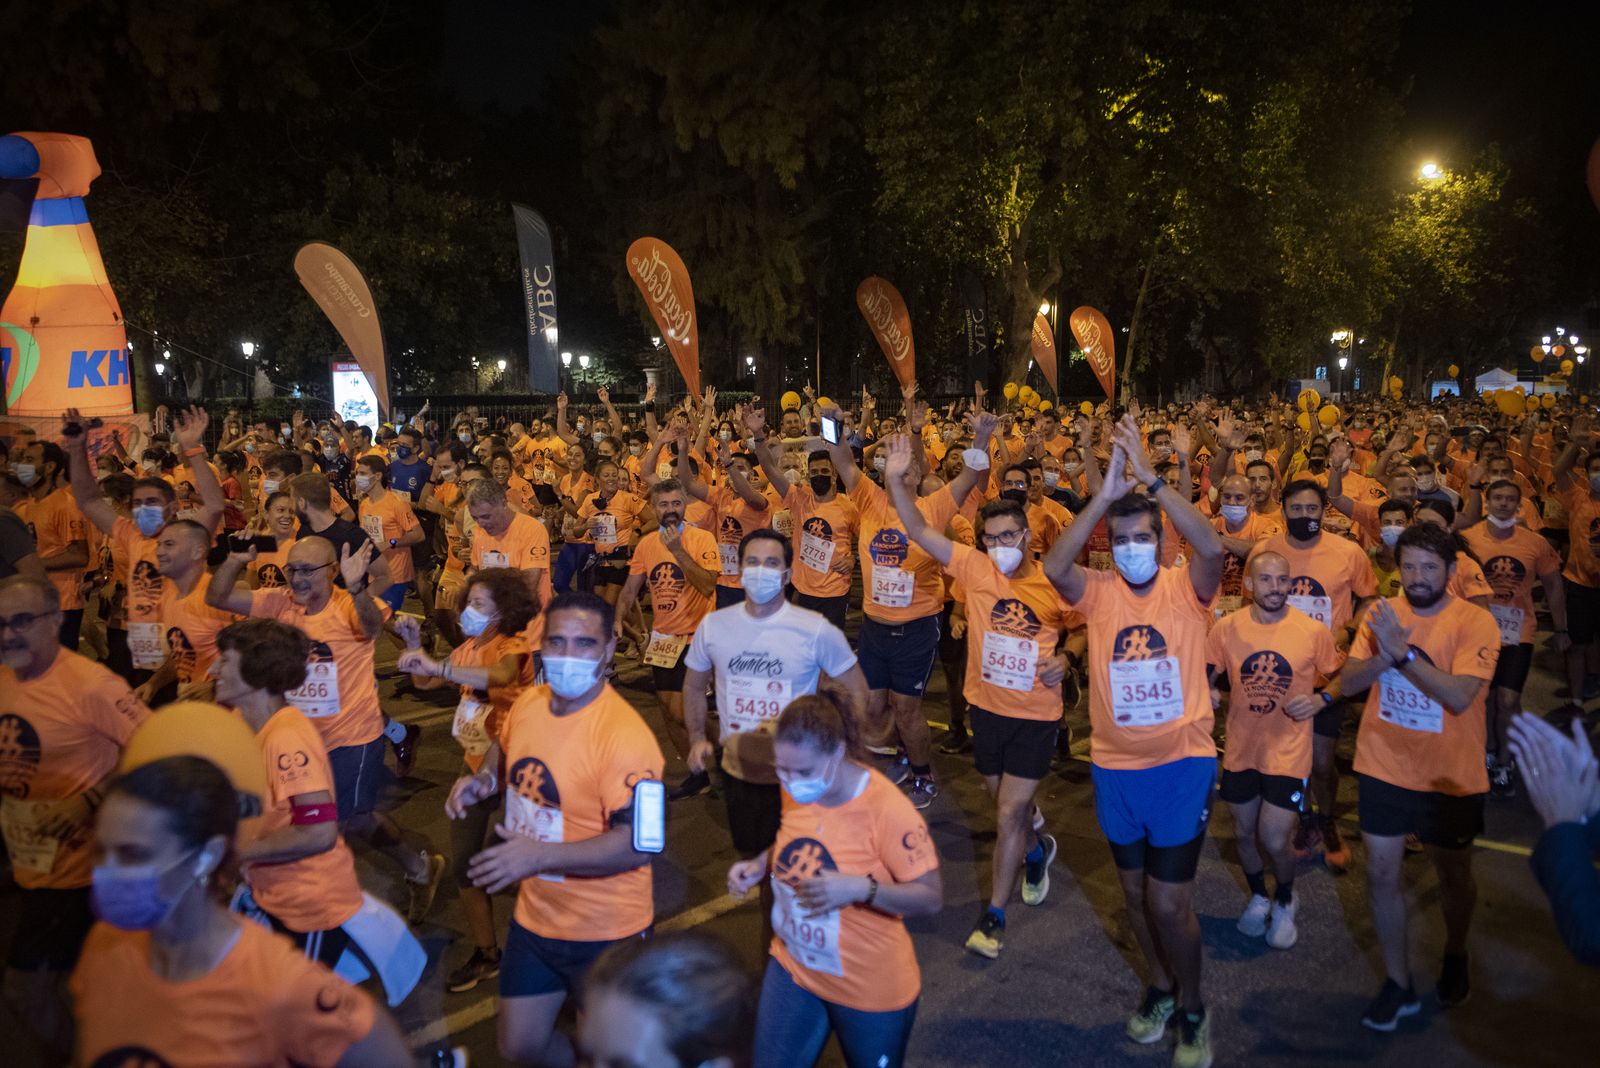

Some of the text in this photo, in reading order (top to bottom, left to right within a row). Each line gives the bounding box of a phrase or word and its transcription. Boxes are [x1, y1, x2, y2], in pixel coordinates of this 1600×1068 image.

[803, 544, 826, 561] 2778
[876, 581, 905, 595] 3474
[653, 641, 679, 655] 3484
[988, 651, 1027, 672] 5438
[1122, 681, 1173, 703] 3545
[1387, 687, 1431, 711] 6333
[735, 698, 780, 718] 5439
